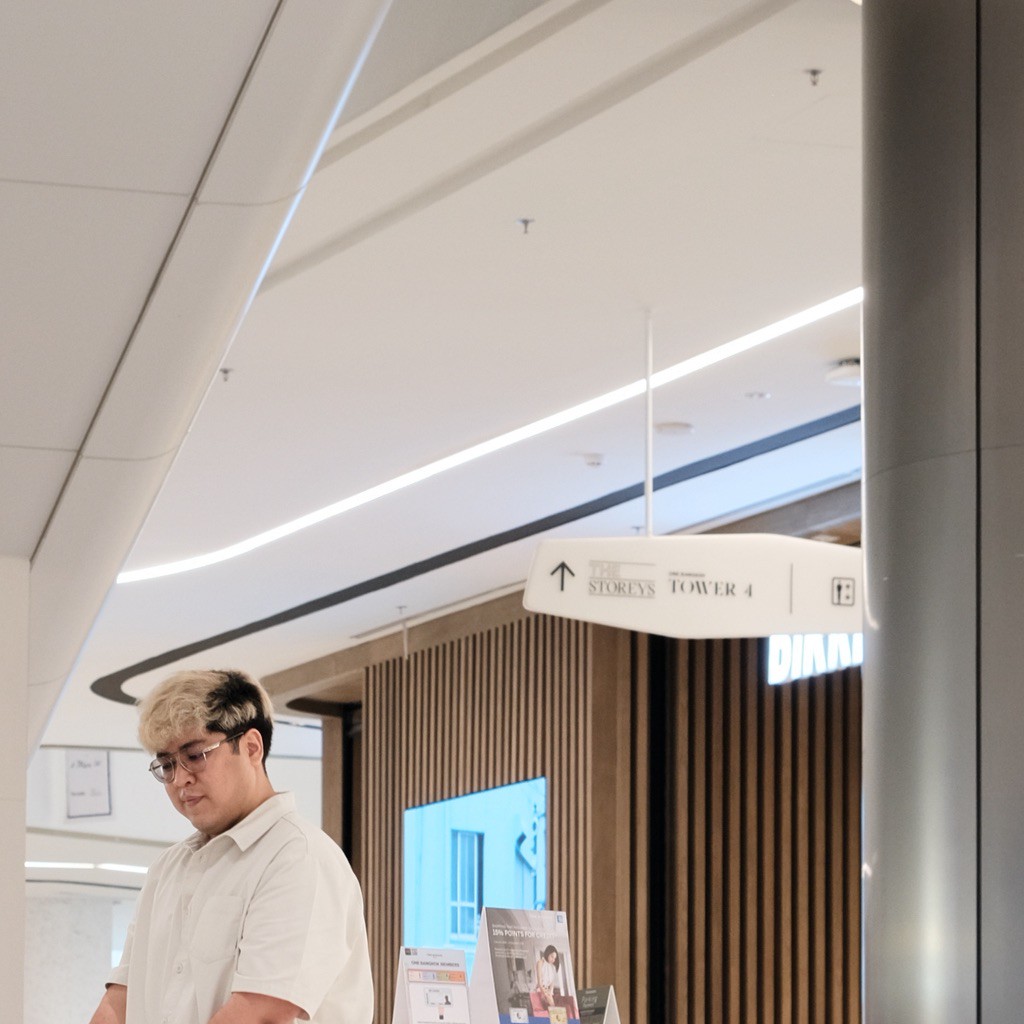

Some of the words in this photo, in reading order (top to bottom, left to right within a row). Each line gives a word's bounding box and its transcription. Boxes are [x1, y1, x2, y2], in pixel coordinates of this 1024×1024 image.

[588, 579, 656, 596] STOREYS
[668, 579, 736, 597] TOWER
[744, 583, 753, 598] 4
